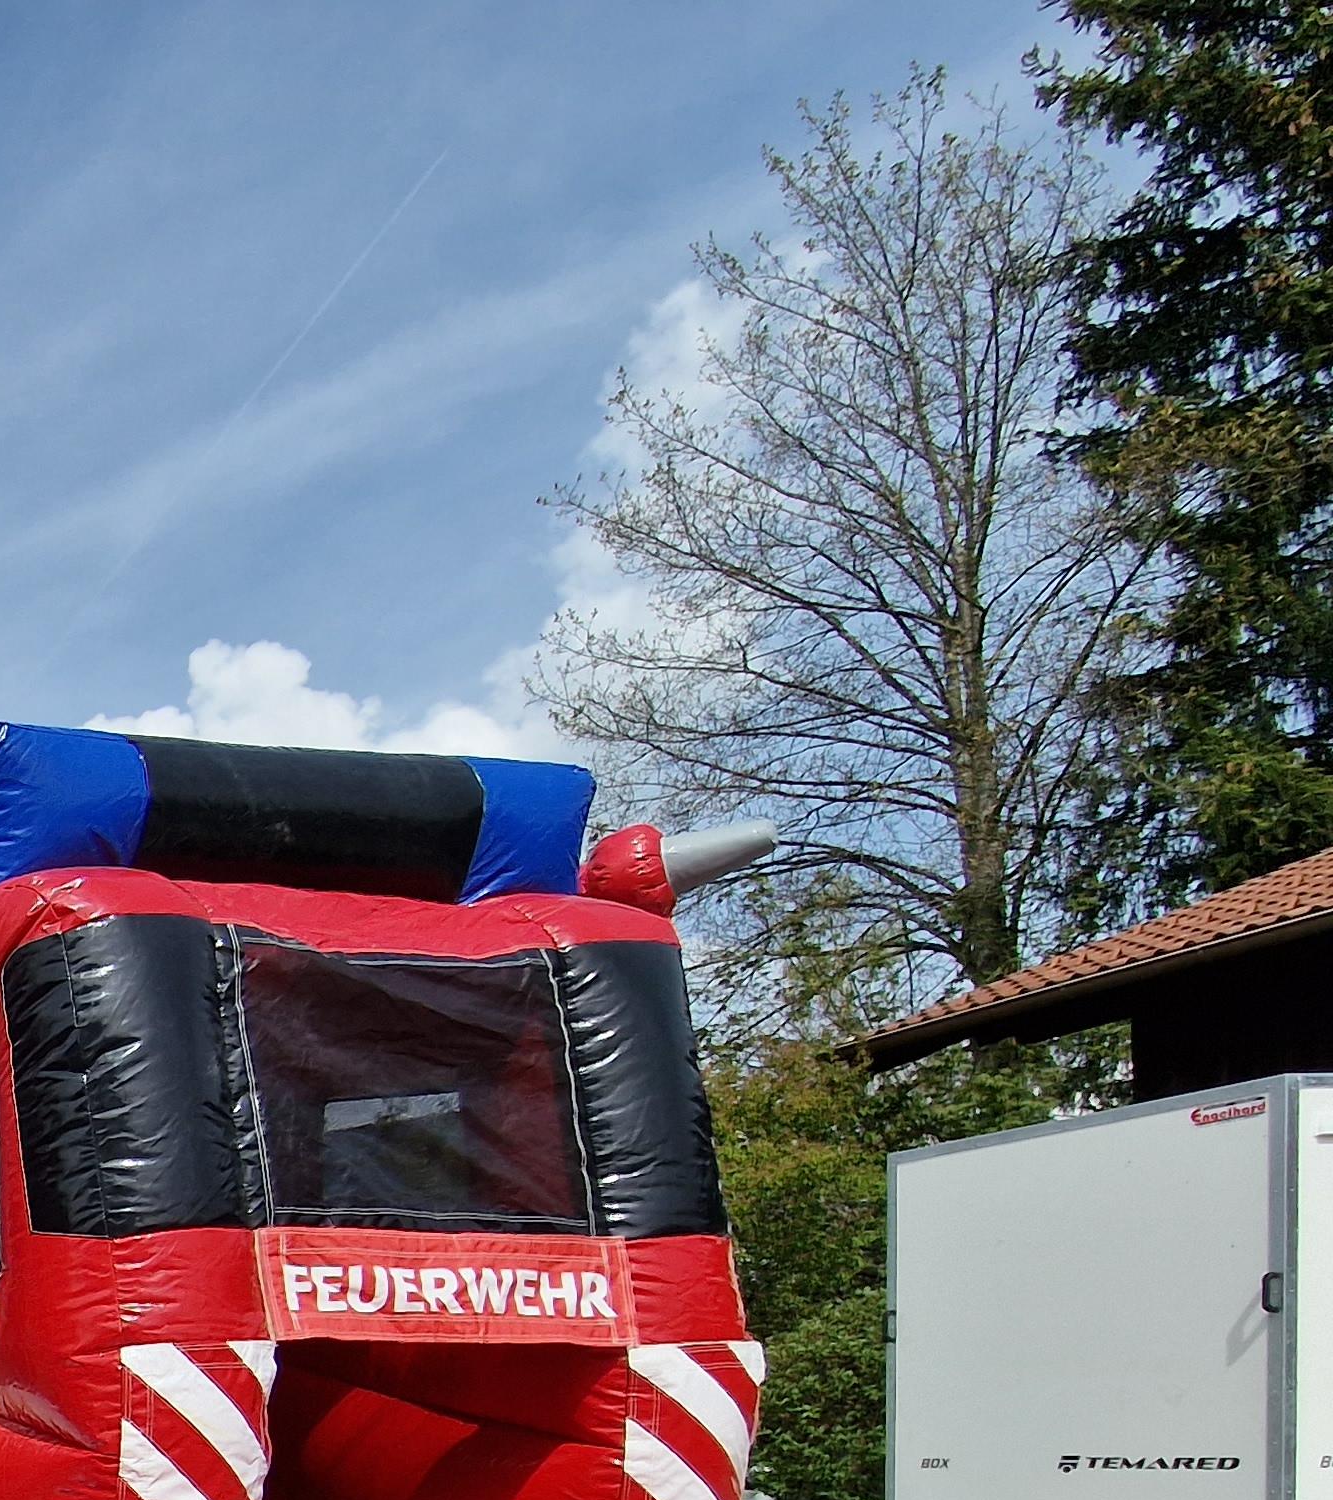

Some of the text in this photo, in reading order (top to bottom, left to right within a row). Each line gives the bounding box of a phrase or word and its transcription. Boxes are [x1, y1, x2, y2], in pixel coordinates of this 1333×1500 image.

[283, 1263, 619, 1318] FEUERWEHR
[920, 1456, 1241, 1471] BOX TEMARED
